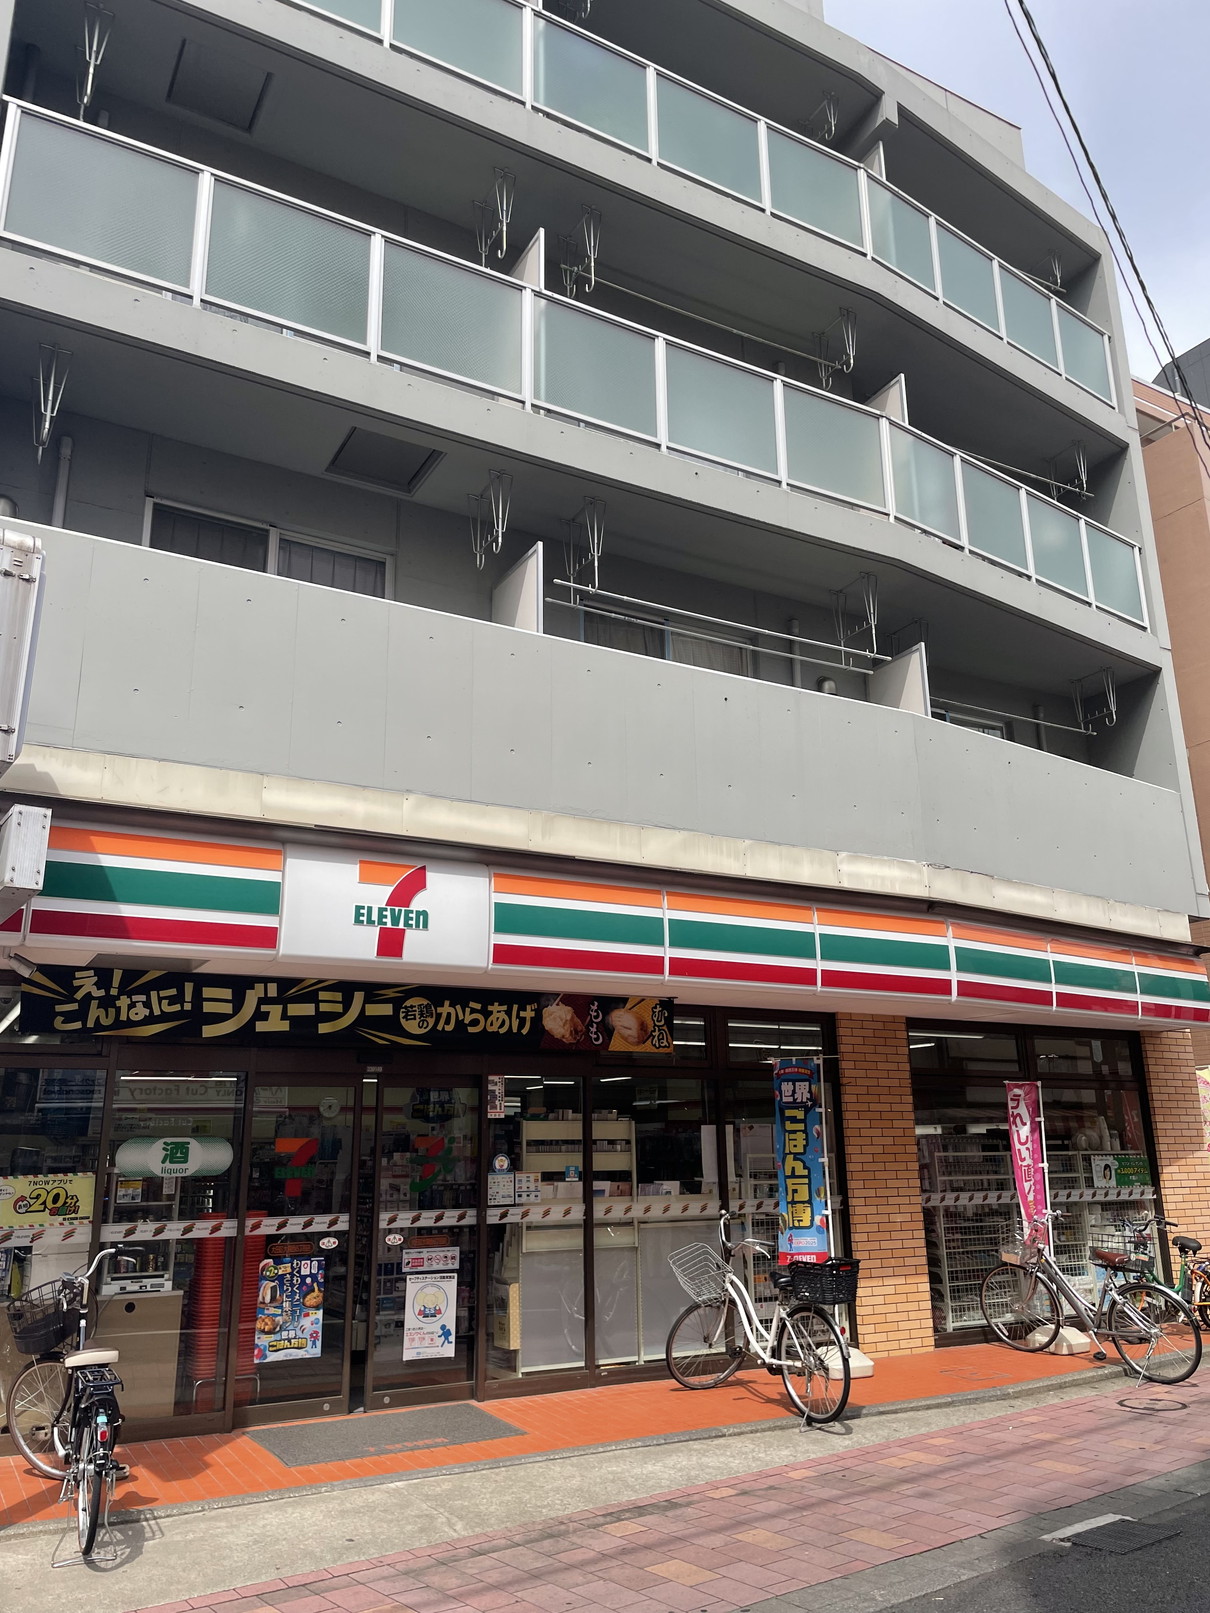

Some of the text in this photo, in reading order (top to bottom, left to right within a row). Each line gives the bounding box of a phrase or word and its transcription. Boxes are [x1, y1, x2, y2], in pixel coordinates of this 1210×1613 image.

[358, 859, 427, 959] 7
[53, 982, 193, 1031] こんなに!
[73, 969, 123, 1000] え!
[201, 982, 394, 1038] ジューシー
[436, 1000, 537, 1036] からあげ
[588, 1000, 603, 1046] もも
[651, 1004, 670, 1049] むね
[781, 1081, 811, 1102] 世界
[160, 1165, 189, 1175] liquor
[161, 1140, 190, 1165] 酒
[784, 1108, 812, 1228] ごはん万博
